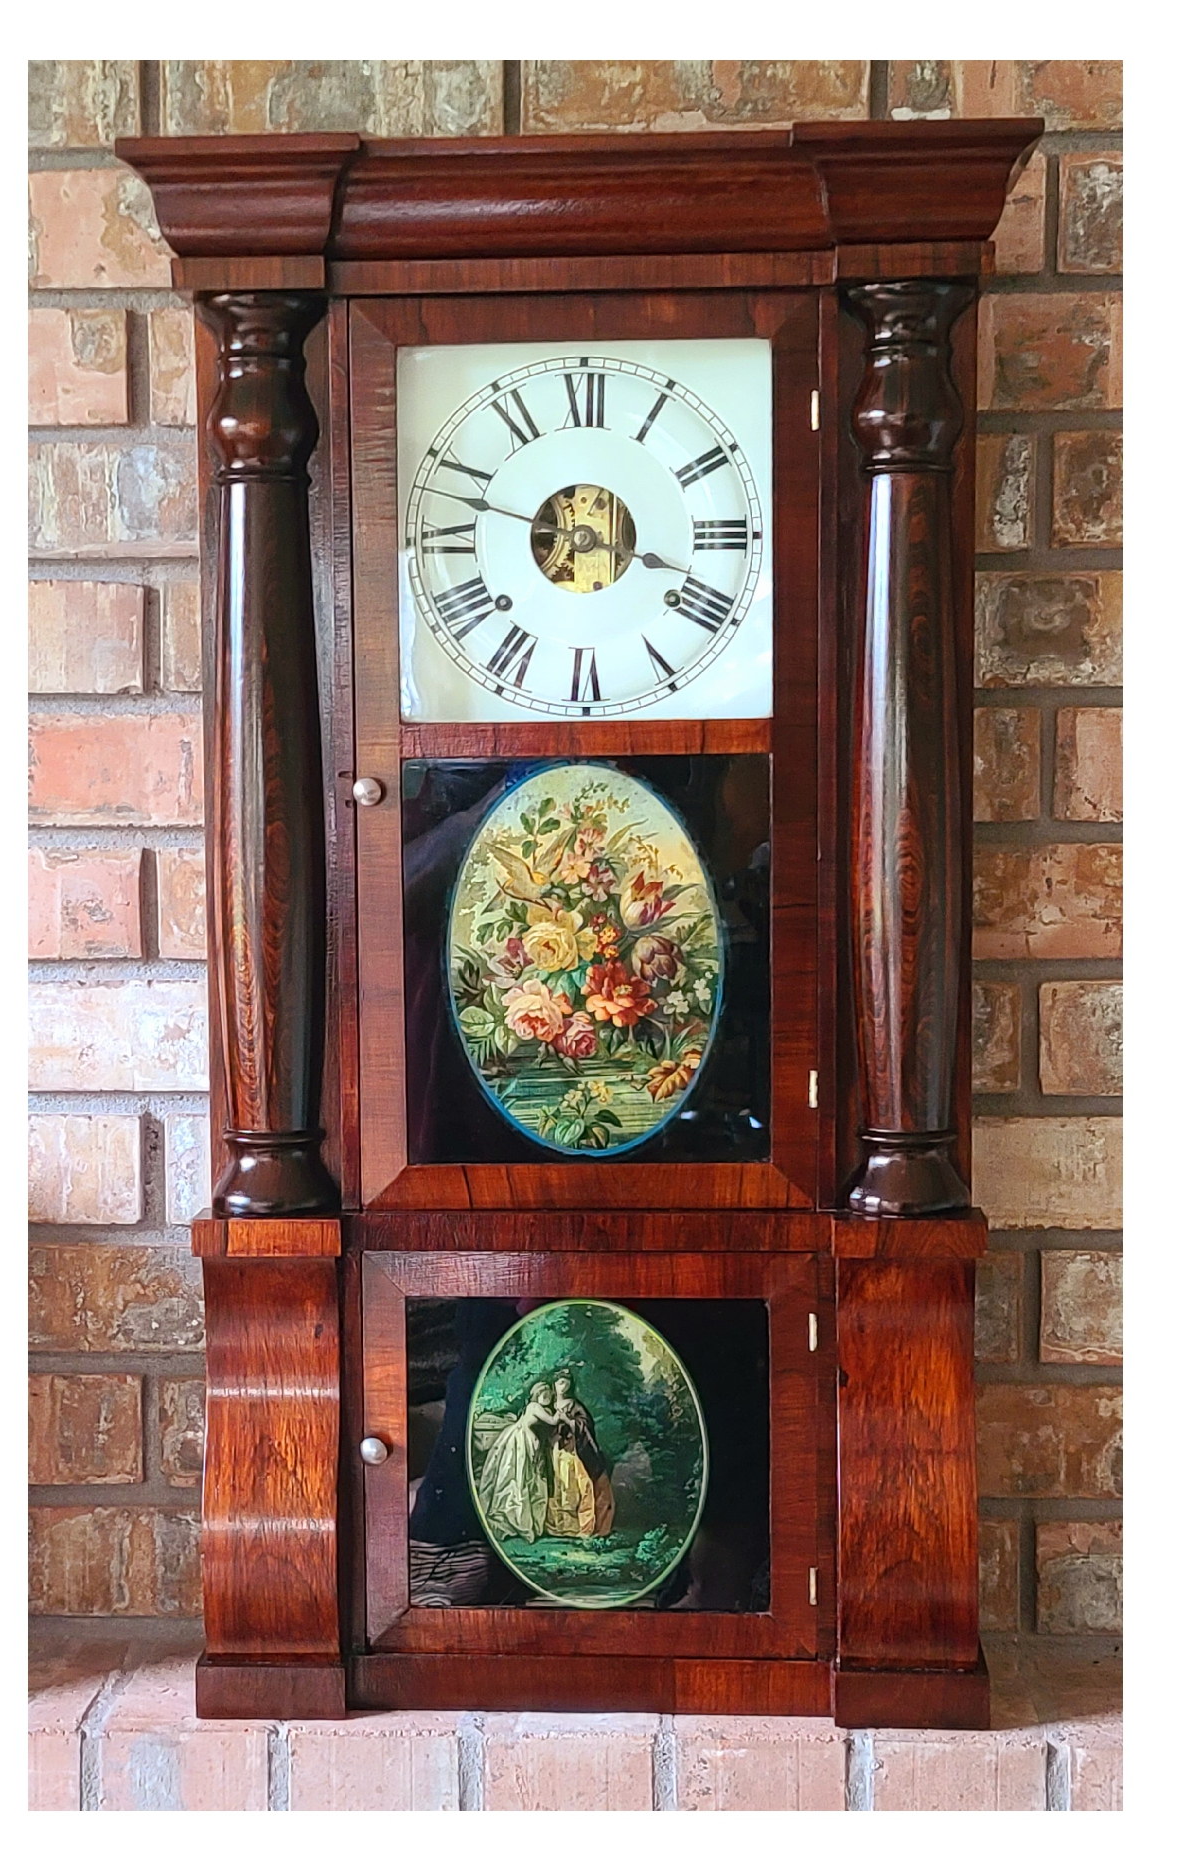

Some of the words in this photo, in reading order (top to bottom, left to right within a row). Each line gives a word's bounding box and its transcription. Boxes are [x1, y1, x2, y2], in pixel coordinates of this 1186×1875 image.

[481, 383, 547, 461] XI
[555, 373, 615, 431] XII
[629, 388, 676, 445] I
[434, 441, 498, 503] X
[669, 437, 740, 492] II
[421, 514, 478, 569] IX
[691, 514, 748, 559] III
[430, 570, 496, 650] VIII
[663, 565, 738, 646] IIII
[479, 620, 538, 694] VII
[561, 647, 610, 702] VI
[641, 634, 684, 686] V
